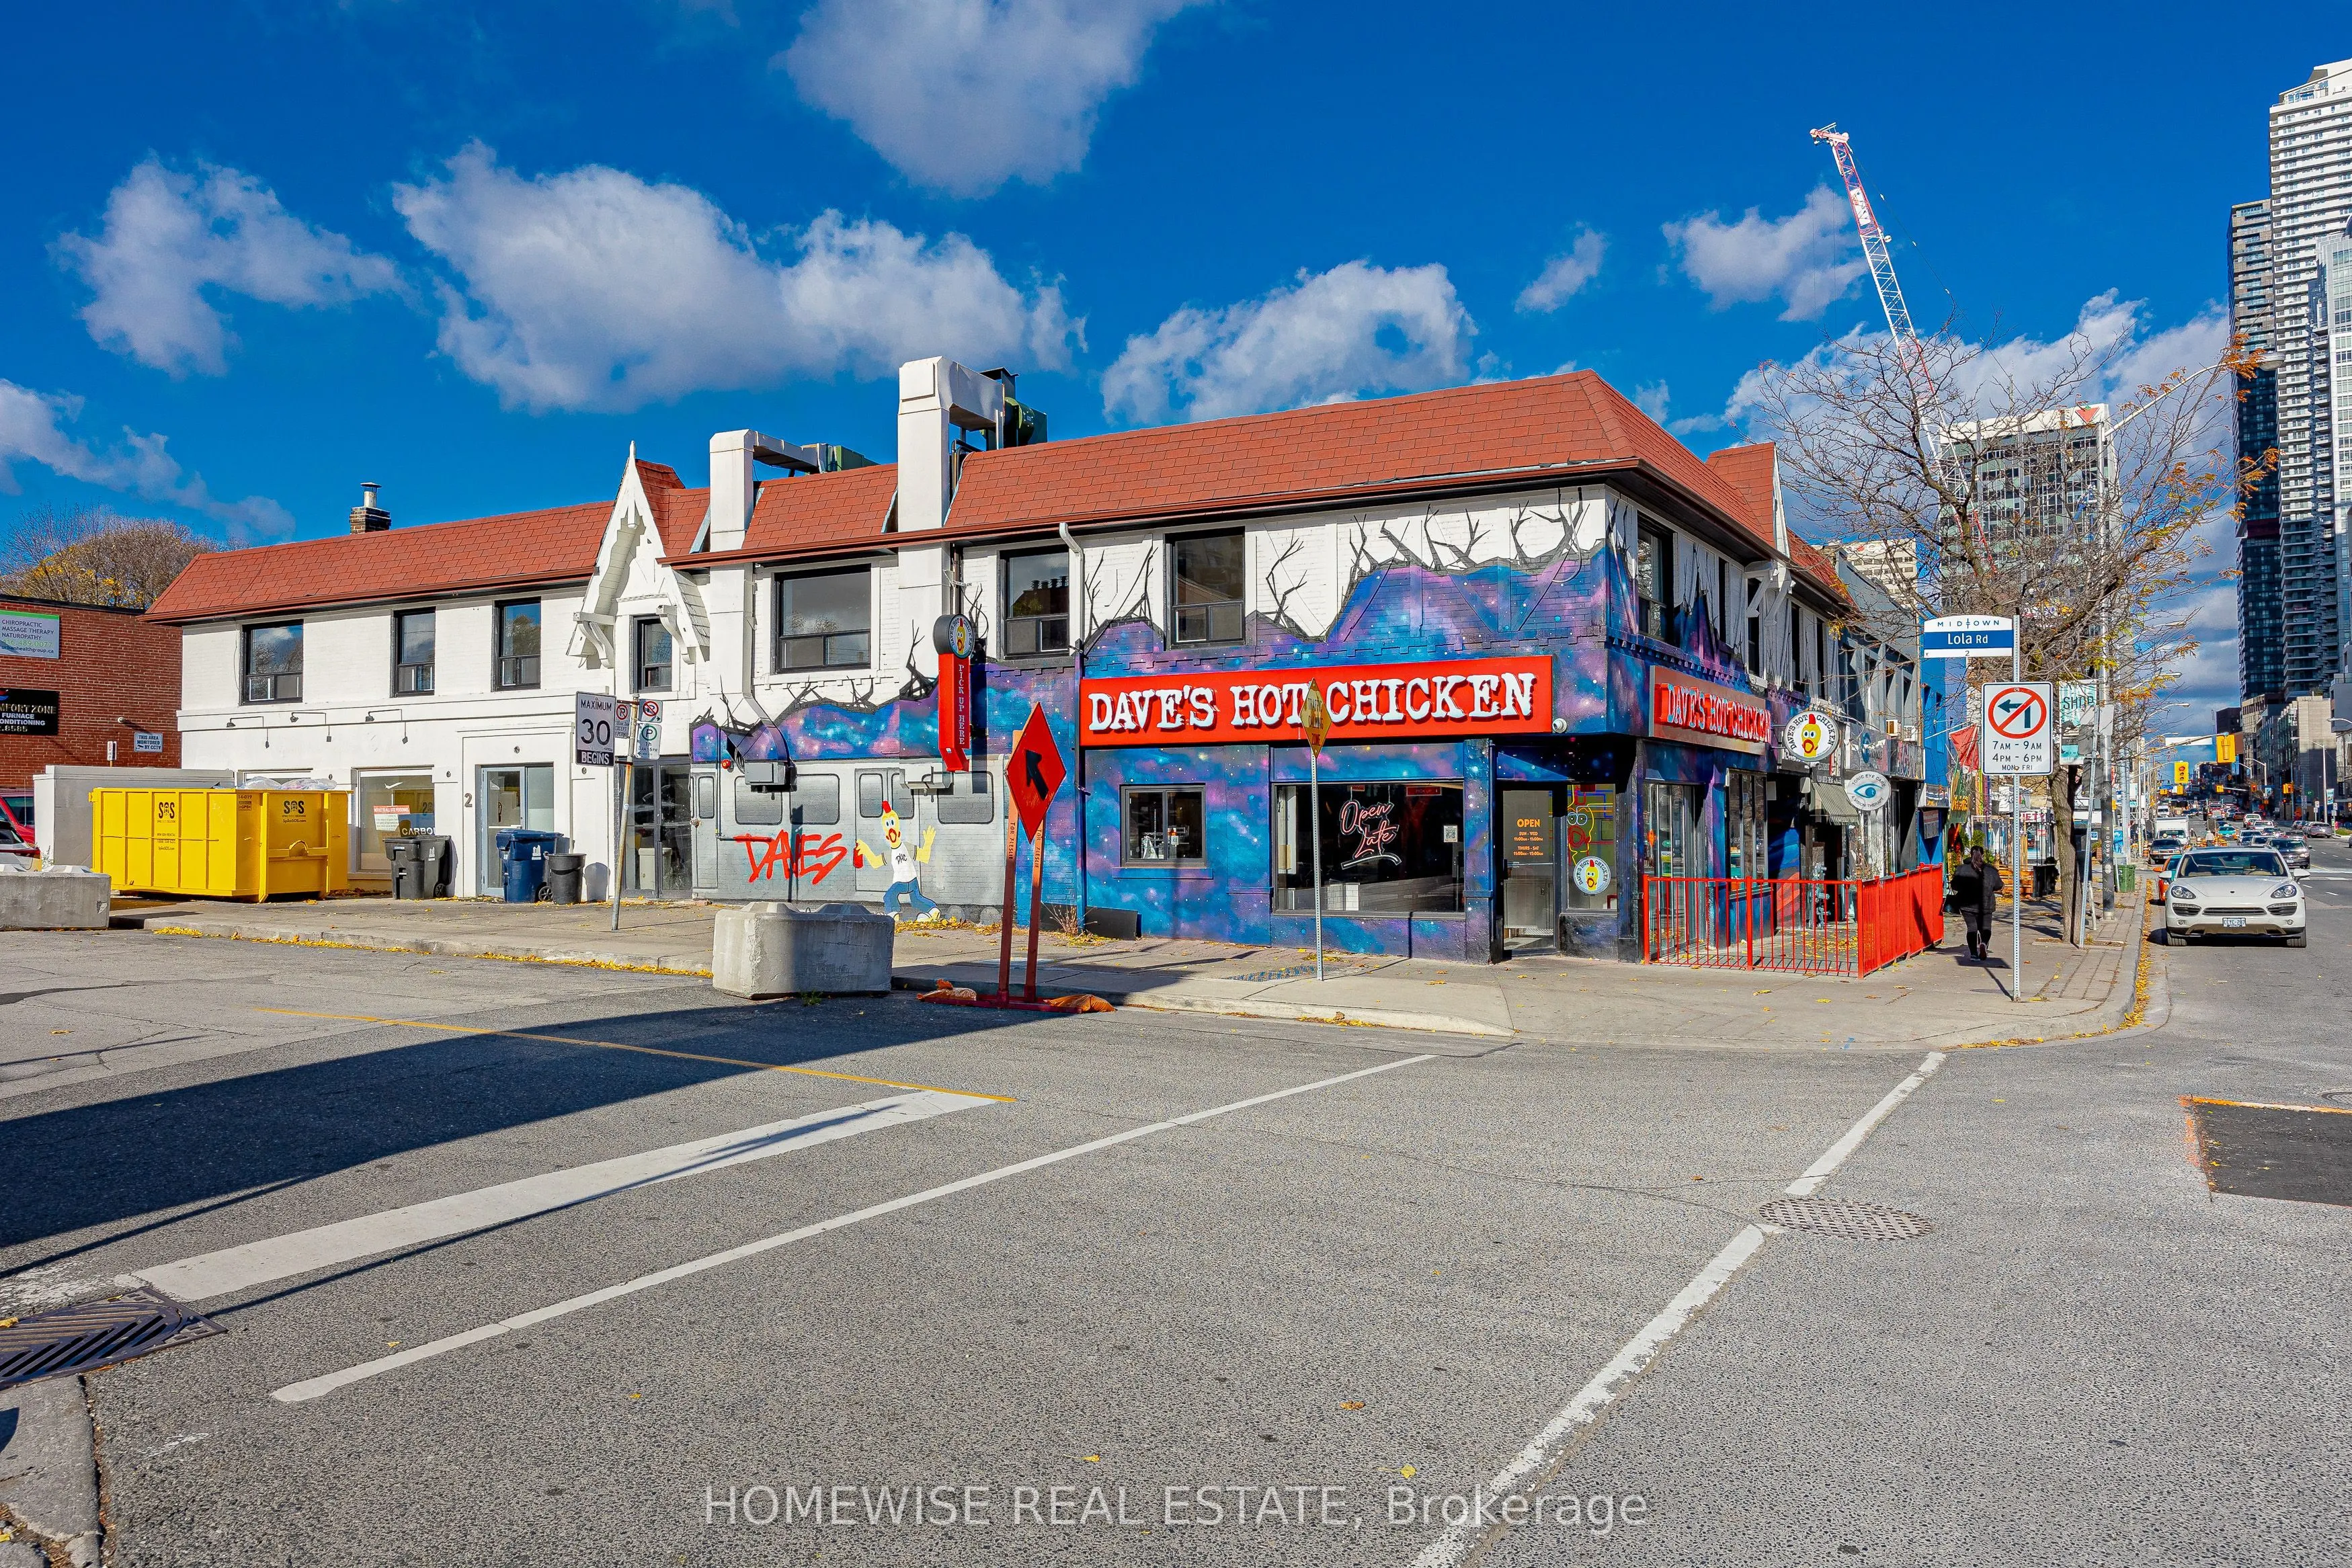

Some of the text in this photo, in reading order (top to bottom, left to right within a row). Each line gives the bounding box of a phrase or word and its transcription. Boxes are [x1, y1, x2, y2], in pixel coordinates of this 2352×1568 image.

[1, 619, 42, 628] CHIROPRACTIC
[1, 632, 42, 641] NATUROPATHY
[1948, 633, 1988, 645] Lola Rd
[1, 645, 54, 653] urbanhealthgroup.ca
[581, 699, 612, 711] MAXIMUM
[959, 697, 965, 712] UP
[1088, 672, 1537, 732] DAVE'S HOT CHICKEN
[31, 704, 56, 714] ZONE
[1667, 683, 1771, 743] DAVE'S HOT CHICKEN
[580, 718, 611, 746] 30
[1787, 714, 1836, 750] DAVE'S HOT CHICKEN
[1992, 741, 2011, 750] 7AM
[2023, 741, 2041, 750] 9AM
[581, 751, 610, 765] BEGINS
[1992, 753, 2011, 762] 4PM
[2023, 753, 2042, 762] 6PM
[1852, 775, 1865, 786] TONIC
[1875, 776, 1887, 788] CARE
[464, 792, 473, 807] 2
[1340, 800, 1392, 834] Open
[1516, 818, 1541, 827] OPEN
[2022, 812, 2047, 821] IETY
[1354, 819, 1397, 859] Late
[733, 829, 848, 886] DAVES
[895, 853, 908, 865] DHC
[1580, 860, 1590, 868] HOT
[1594, 860, 1608, 882] CHICKEN
